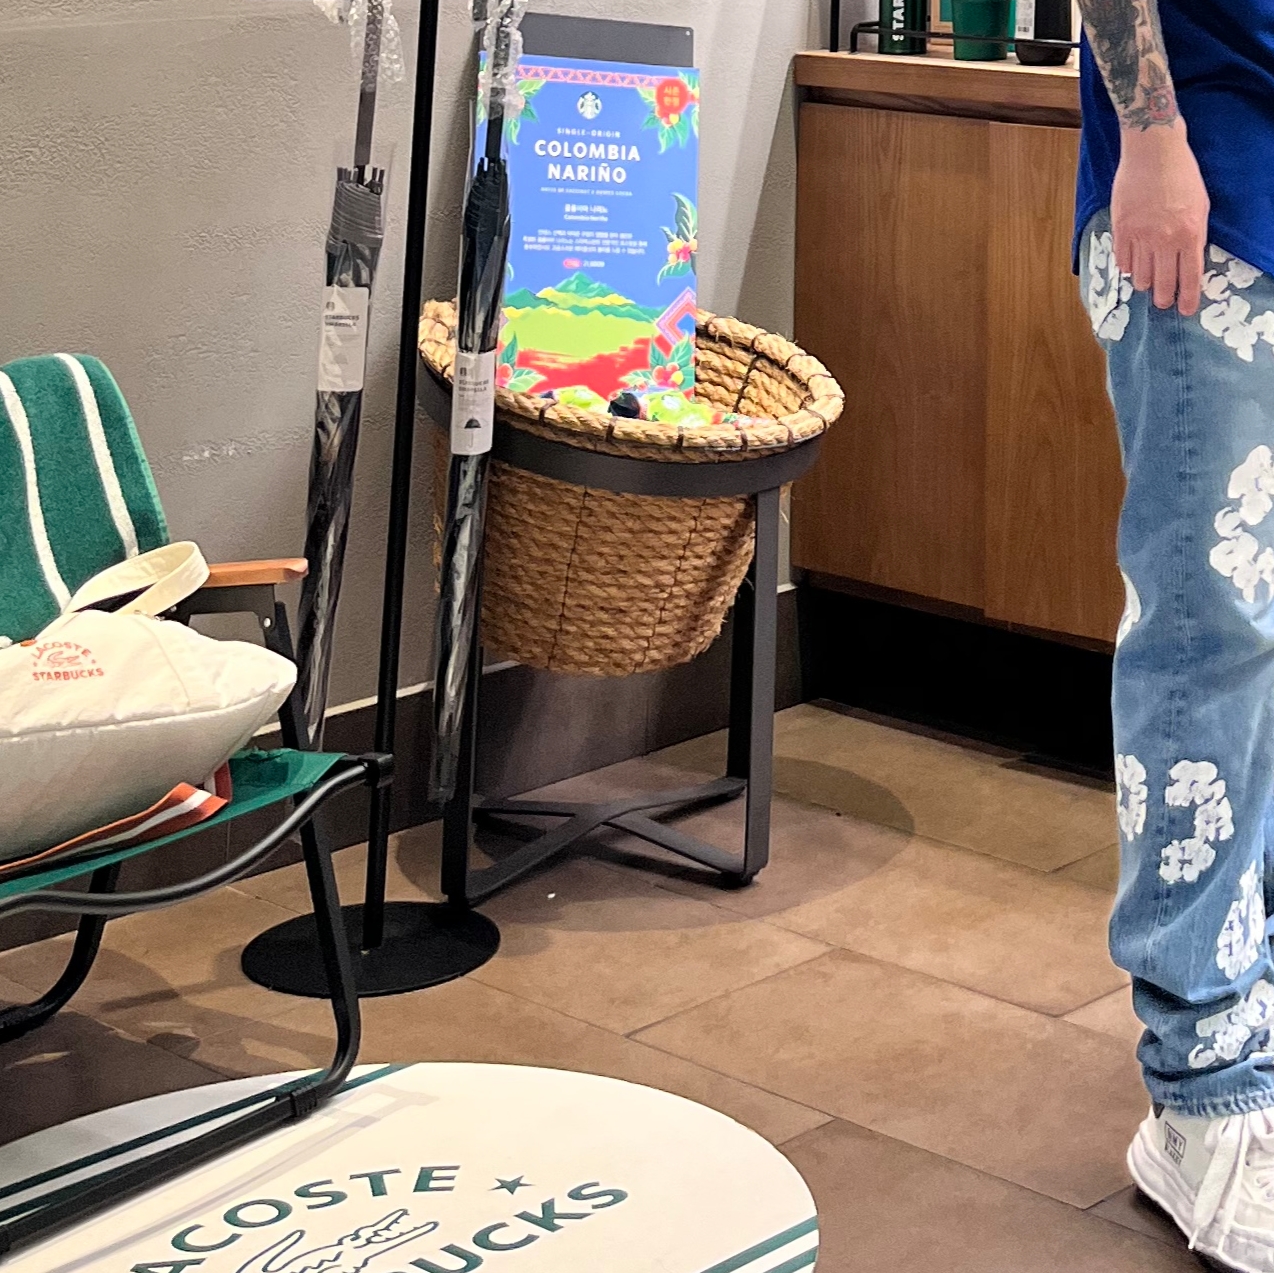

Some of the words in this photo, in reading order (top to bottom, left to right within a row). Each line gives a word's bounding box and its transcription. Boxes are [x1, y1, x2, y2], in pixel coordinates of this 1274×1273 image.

[534, 139, 641, 162] COLOMBIA
[547, 163, 627, 184] NARIÑO
[31, 641, 91, 659] LACOSTE
[32, 667, 105, 682] STARBUCKS
[385, 1181, 629, 1273] UCKS
